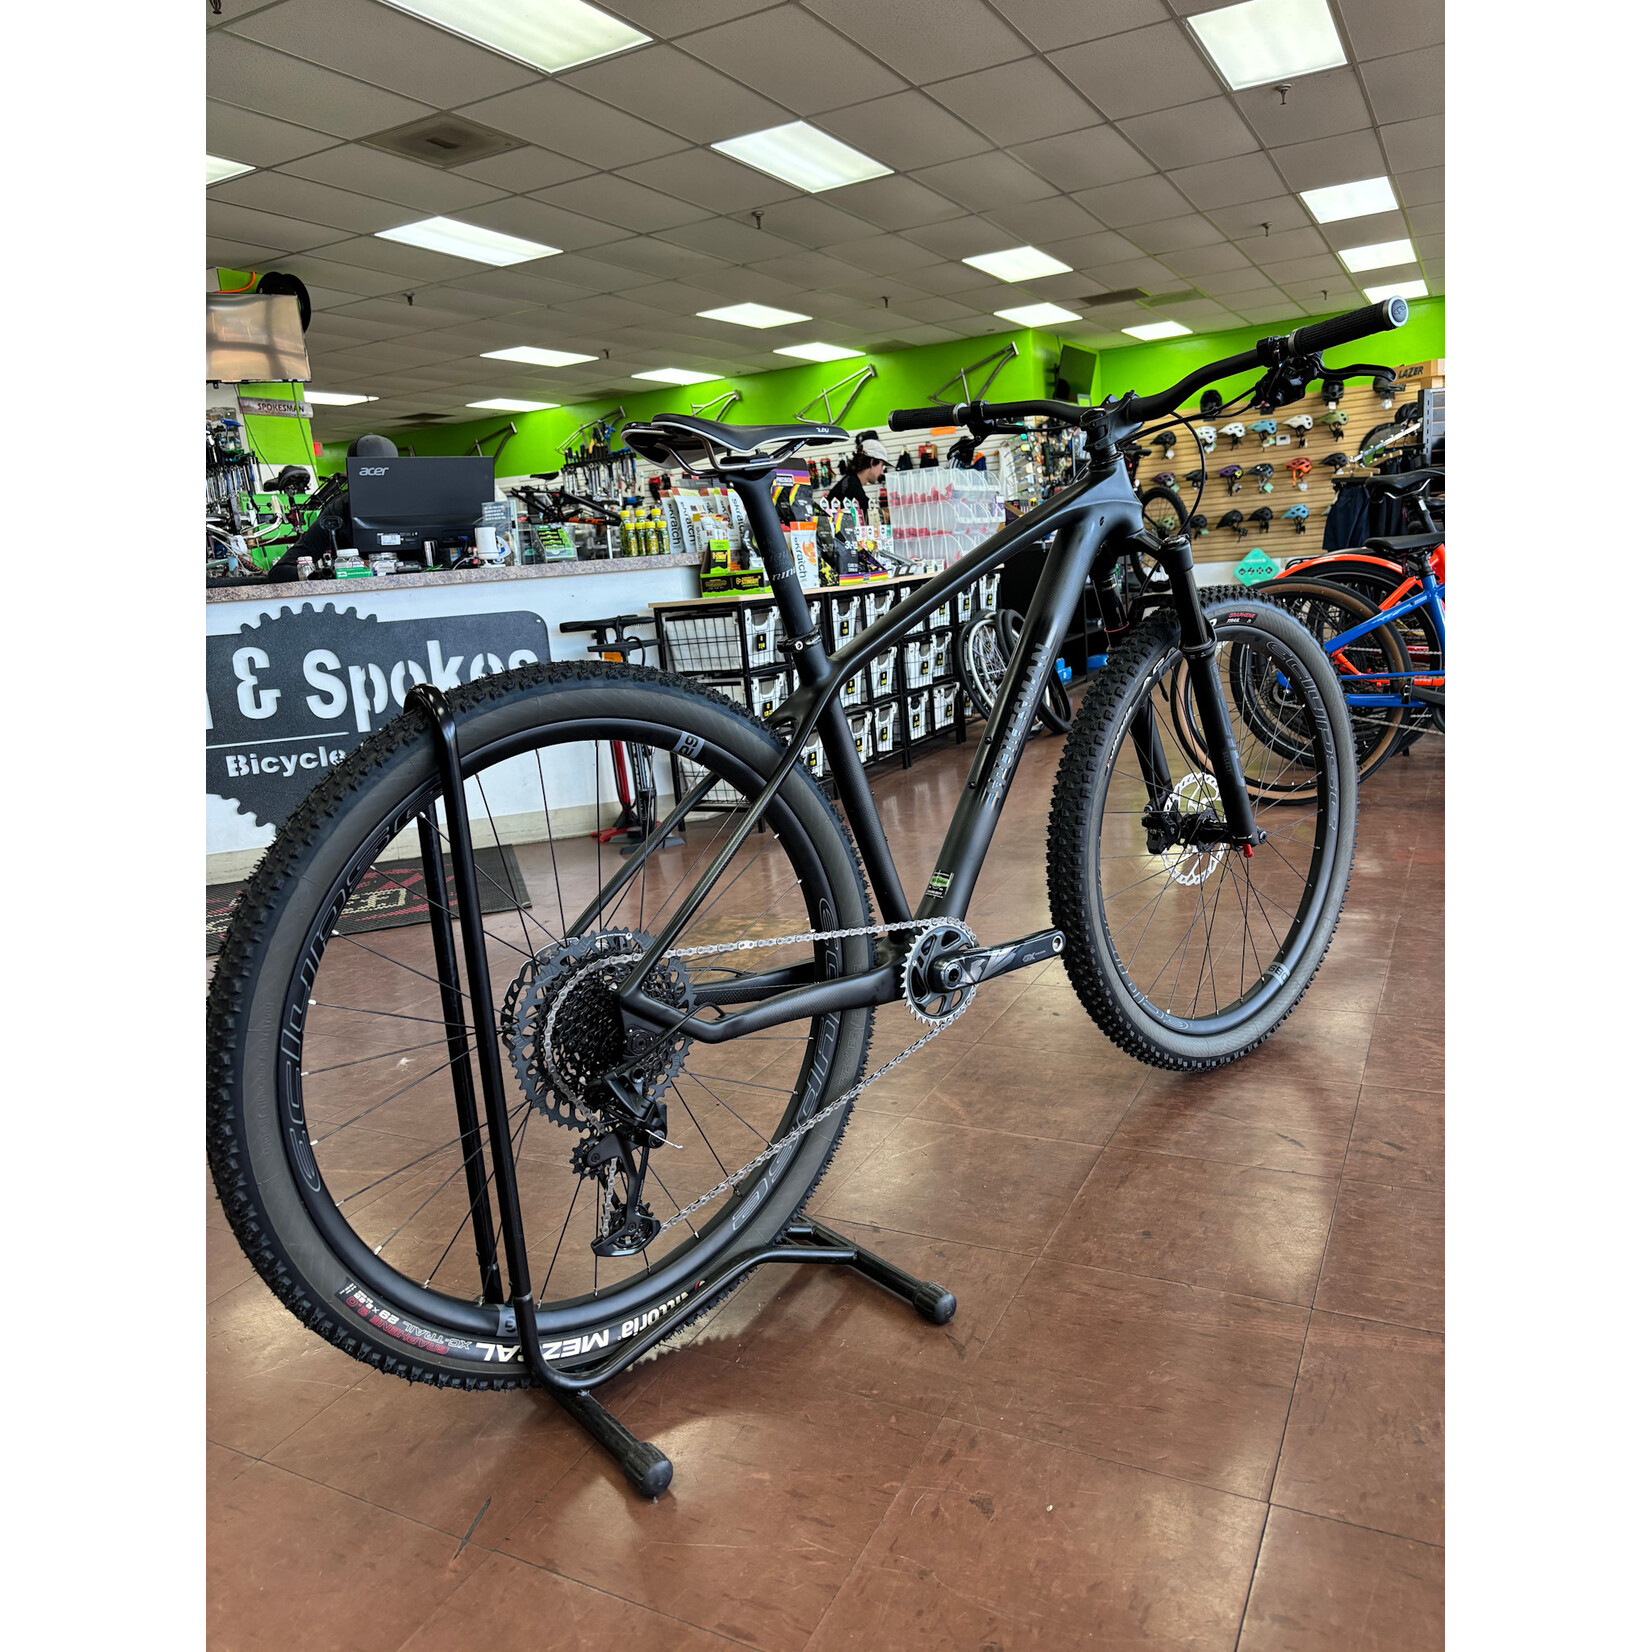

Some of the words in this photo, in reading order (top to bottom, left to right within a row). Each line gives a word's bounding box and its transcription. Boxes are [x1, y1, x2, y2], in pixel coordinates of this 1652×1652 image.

[1398, 366, 1424, 379] LAZER
[257, 403, 305, 412] SPOKESMAN
[359, 466, 389, 476] acer
[668, 503, 681, 545] skratch
[794, 537, 807, 580] skratch
[232, 646, 281, 720] &
[302, 639, 539, 733] Spok
[986, 643, 1051, 799] SPOKESMAN
[678, 735, 699, 757] 29
[226, 747, 347, 777] Bicycle
[1022, 952, 1036, 963] GX
[369, 1315, 449, 1355] GRAPHENE
